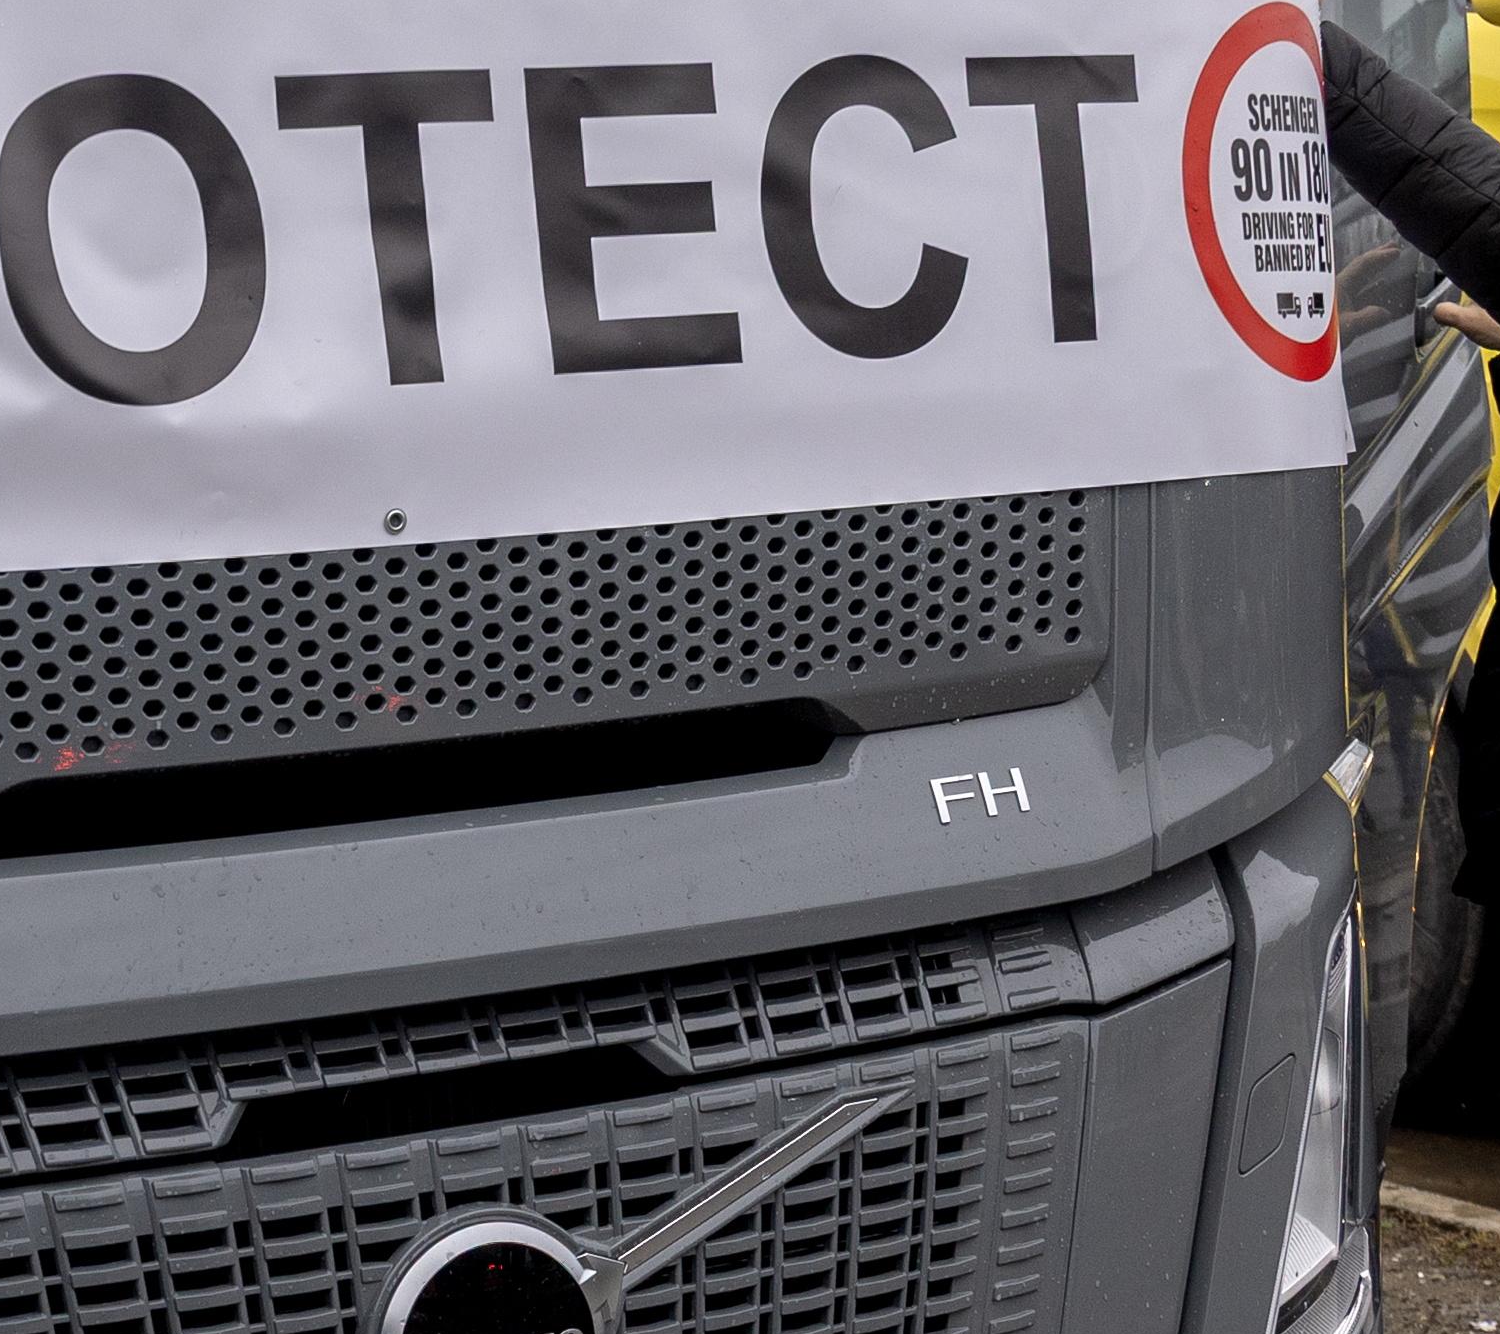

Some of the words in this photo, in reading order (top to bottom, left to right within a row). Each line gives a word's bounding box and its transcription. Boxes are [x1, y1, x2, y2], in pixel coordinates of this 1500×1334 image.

[1247, 93, 1319, 134] SCHENGEN
[1231, 138, 1274, 202] 90
[1279, 152, 1301, 202] IN
[1303, 140, 1329, 205] 180
[1242, 212, 1295, 241] DRIVING
[1297, 212, 1315, 240] FOR
[1316, 213, 1333, 274] EU
[1254, 244, 1303, 272] BANNED
[1305, 245, 1316, 272] BY
[929, 767, 1031, 825] FH
